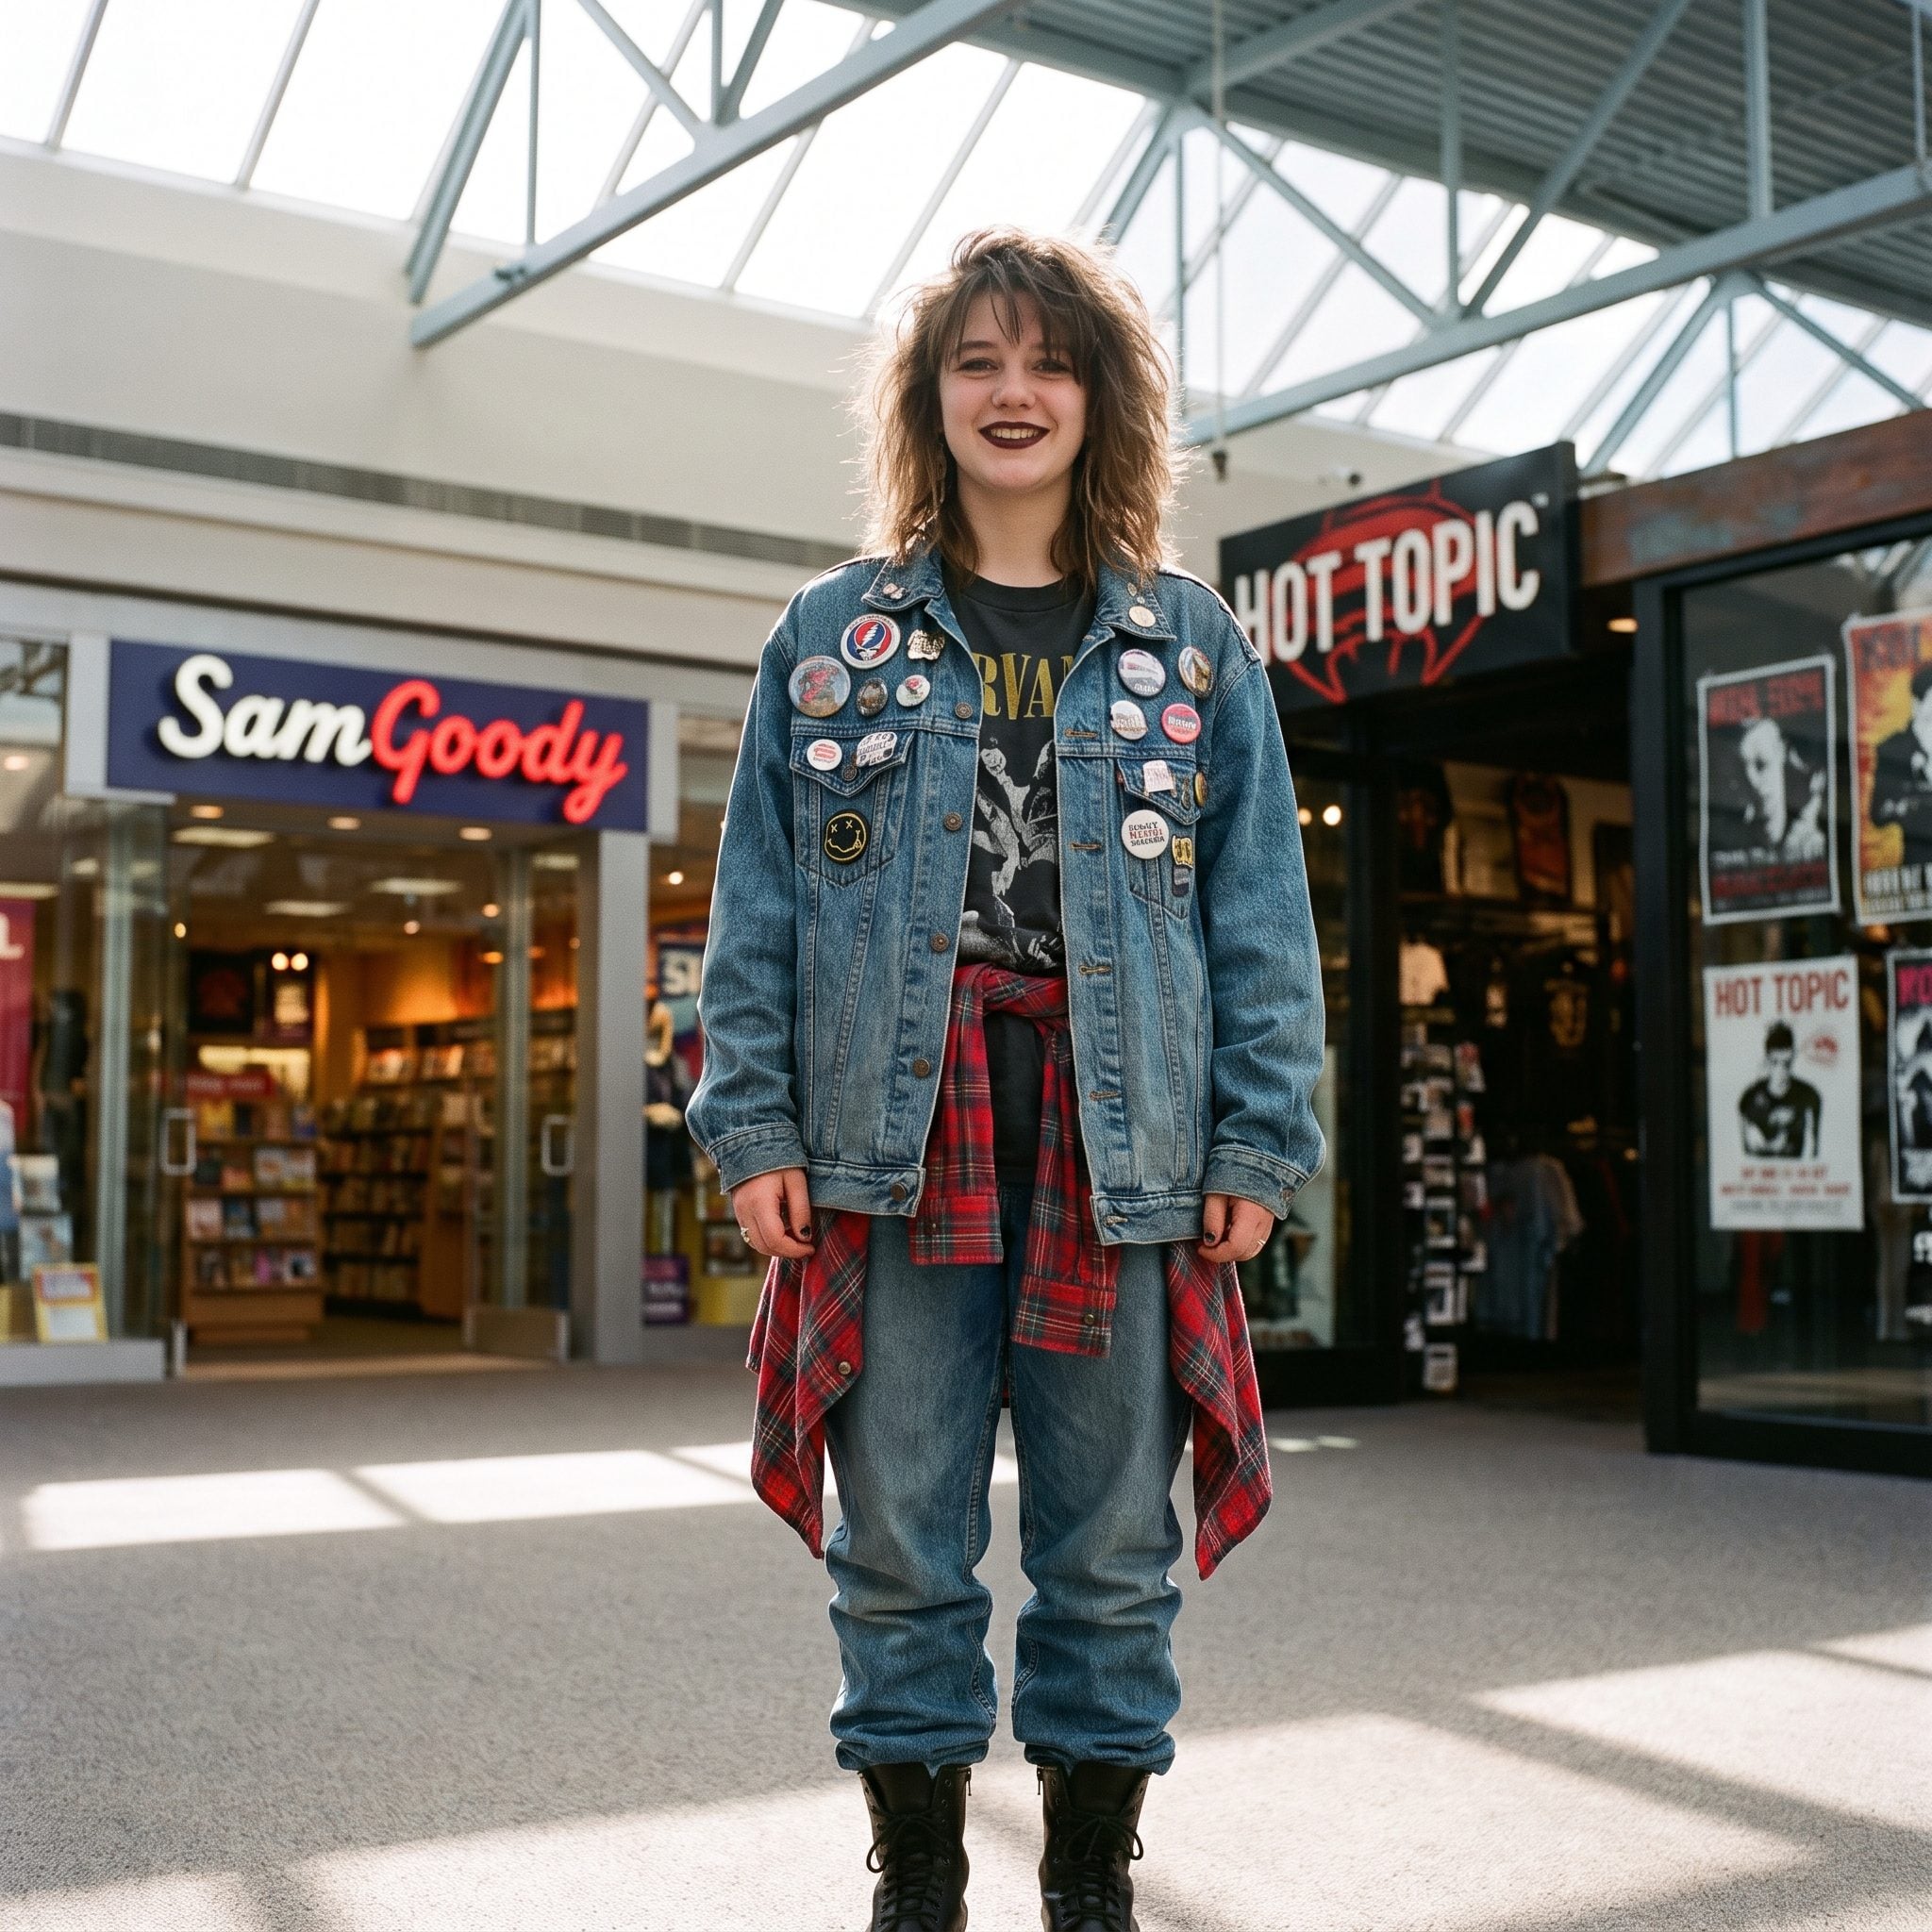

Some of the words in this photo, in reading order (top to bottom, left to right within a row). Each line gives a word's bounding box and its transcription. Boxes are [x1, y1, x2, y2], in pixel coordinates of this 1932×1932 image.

[1234, 550, 1343, 667] HOT
[1354, 500, 1541, 642] TOPIC
[158, 654, 374, 767] Sam
[371, 679, 628, 824] Goody
[1714, 974, 1763, 1017] HOT
[1773, 969, 1850, 1014] TOPIC
